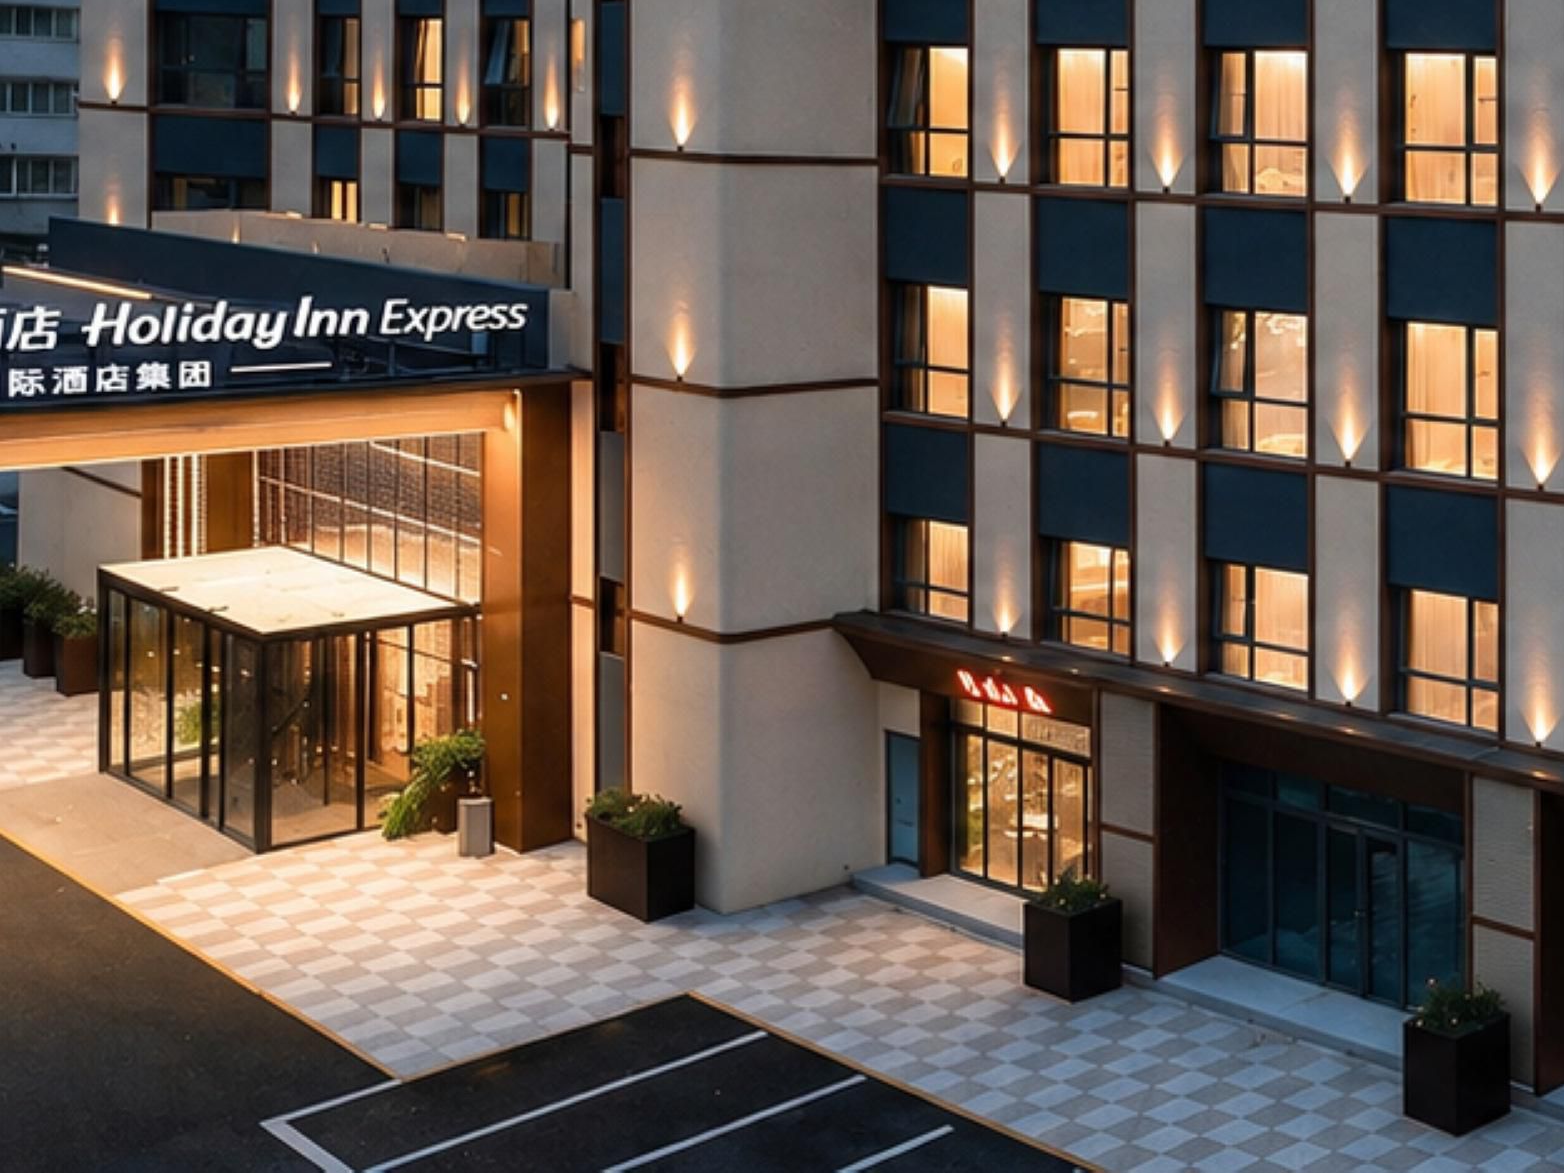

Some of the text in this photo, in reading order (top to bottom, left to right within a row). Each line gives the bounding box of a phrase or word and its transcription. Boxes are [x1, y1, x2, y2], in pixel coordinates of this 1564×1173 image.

[0, 305, 62, 351] 店
[80, 295, 529, 350] Holiday Inn Express
